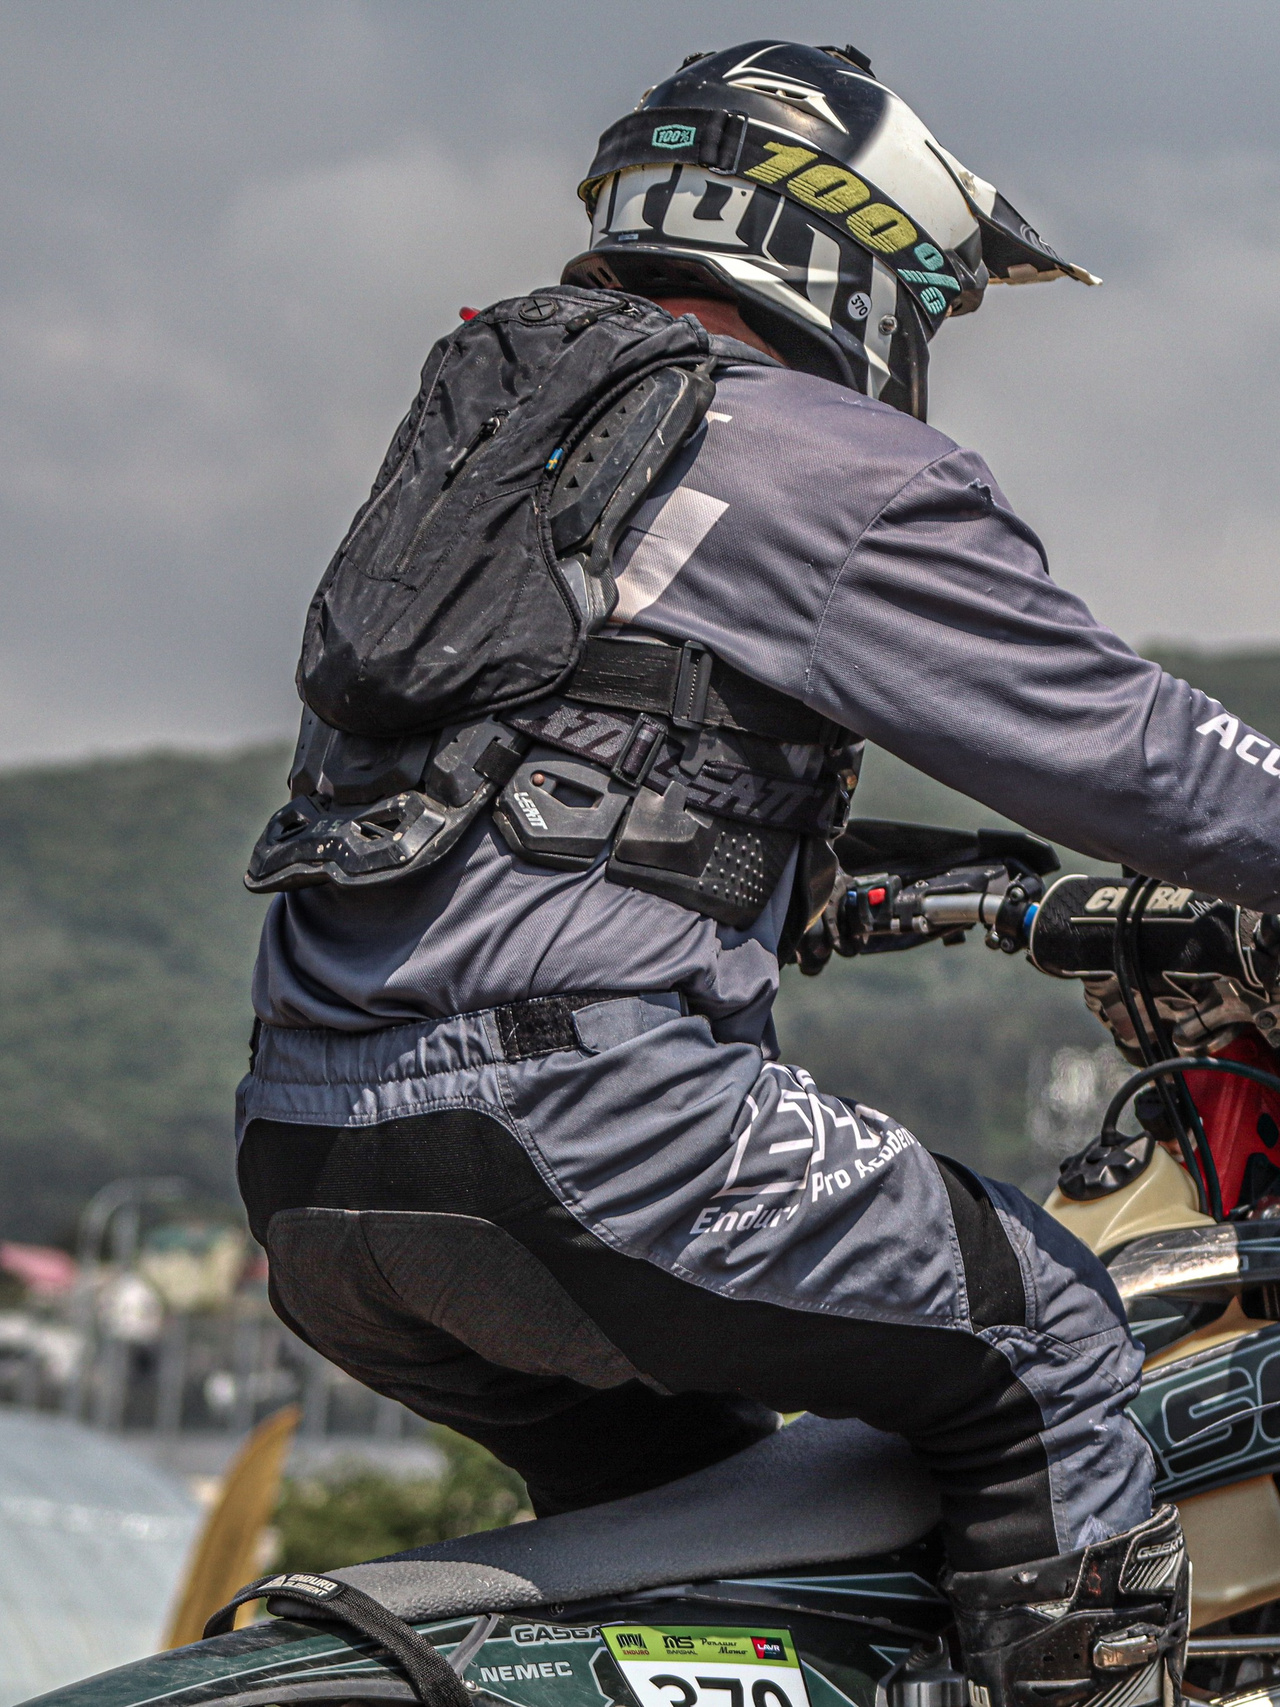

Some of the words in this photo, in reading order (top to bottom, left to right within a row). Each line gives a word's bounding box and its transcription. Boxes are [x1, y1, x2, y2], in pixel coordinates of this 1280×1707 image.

[657, 129, 691, 143] 100%
[744, 141, 961, 315] 100%
[851, 294, 869, 317] 370
[689, 1202, 800, 1235] Endur
[811, 1168, 852, 1203] Pro
[281, 1580, 329, 1597] ELEMENT
[287, 1573, 338, 1592] ENDURO
[479, 1661, 574, 1683] NEMEC
